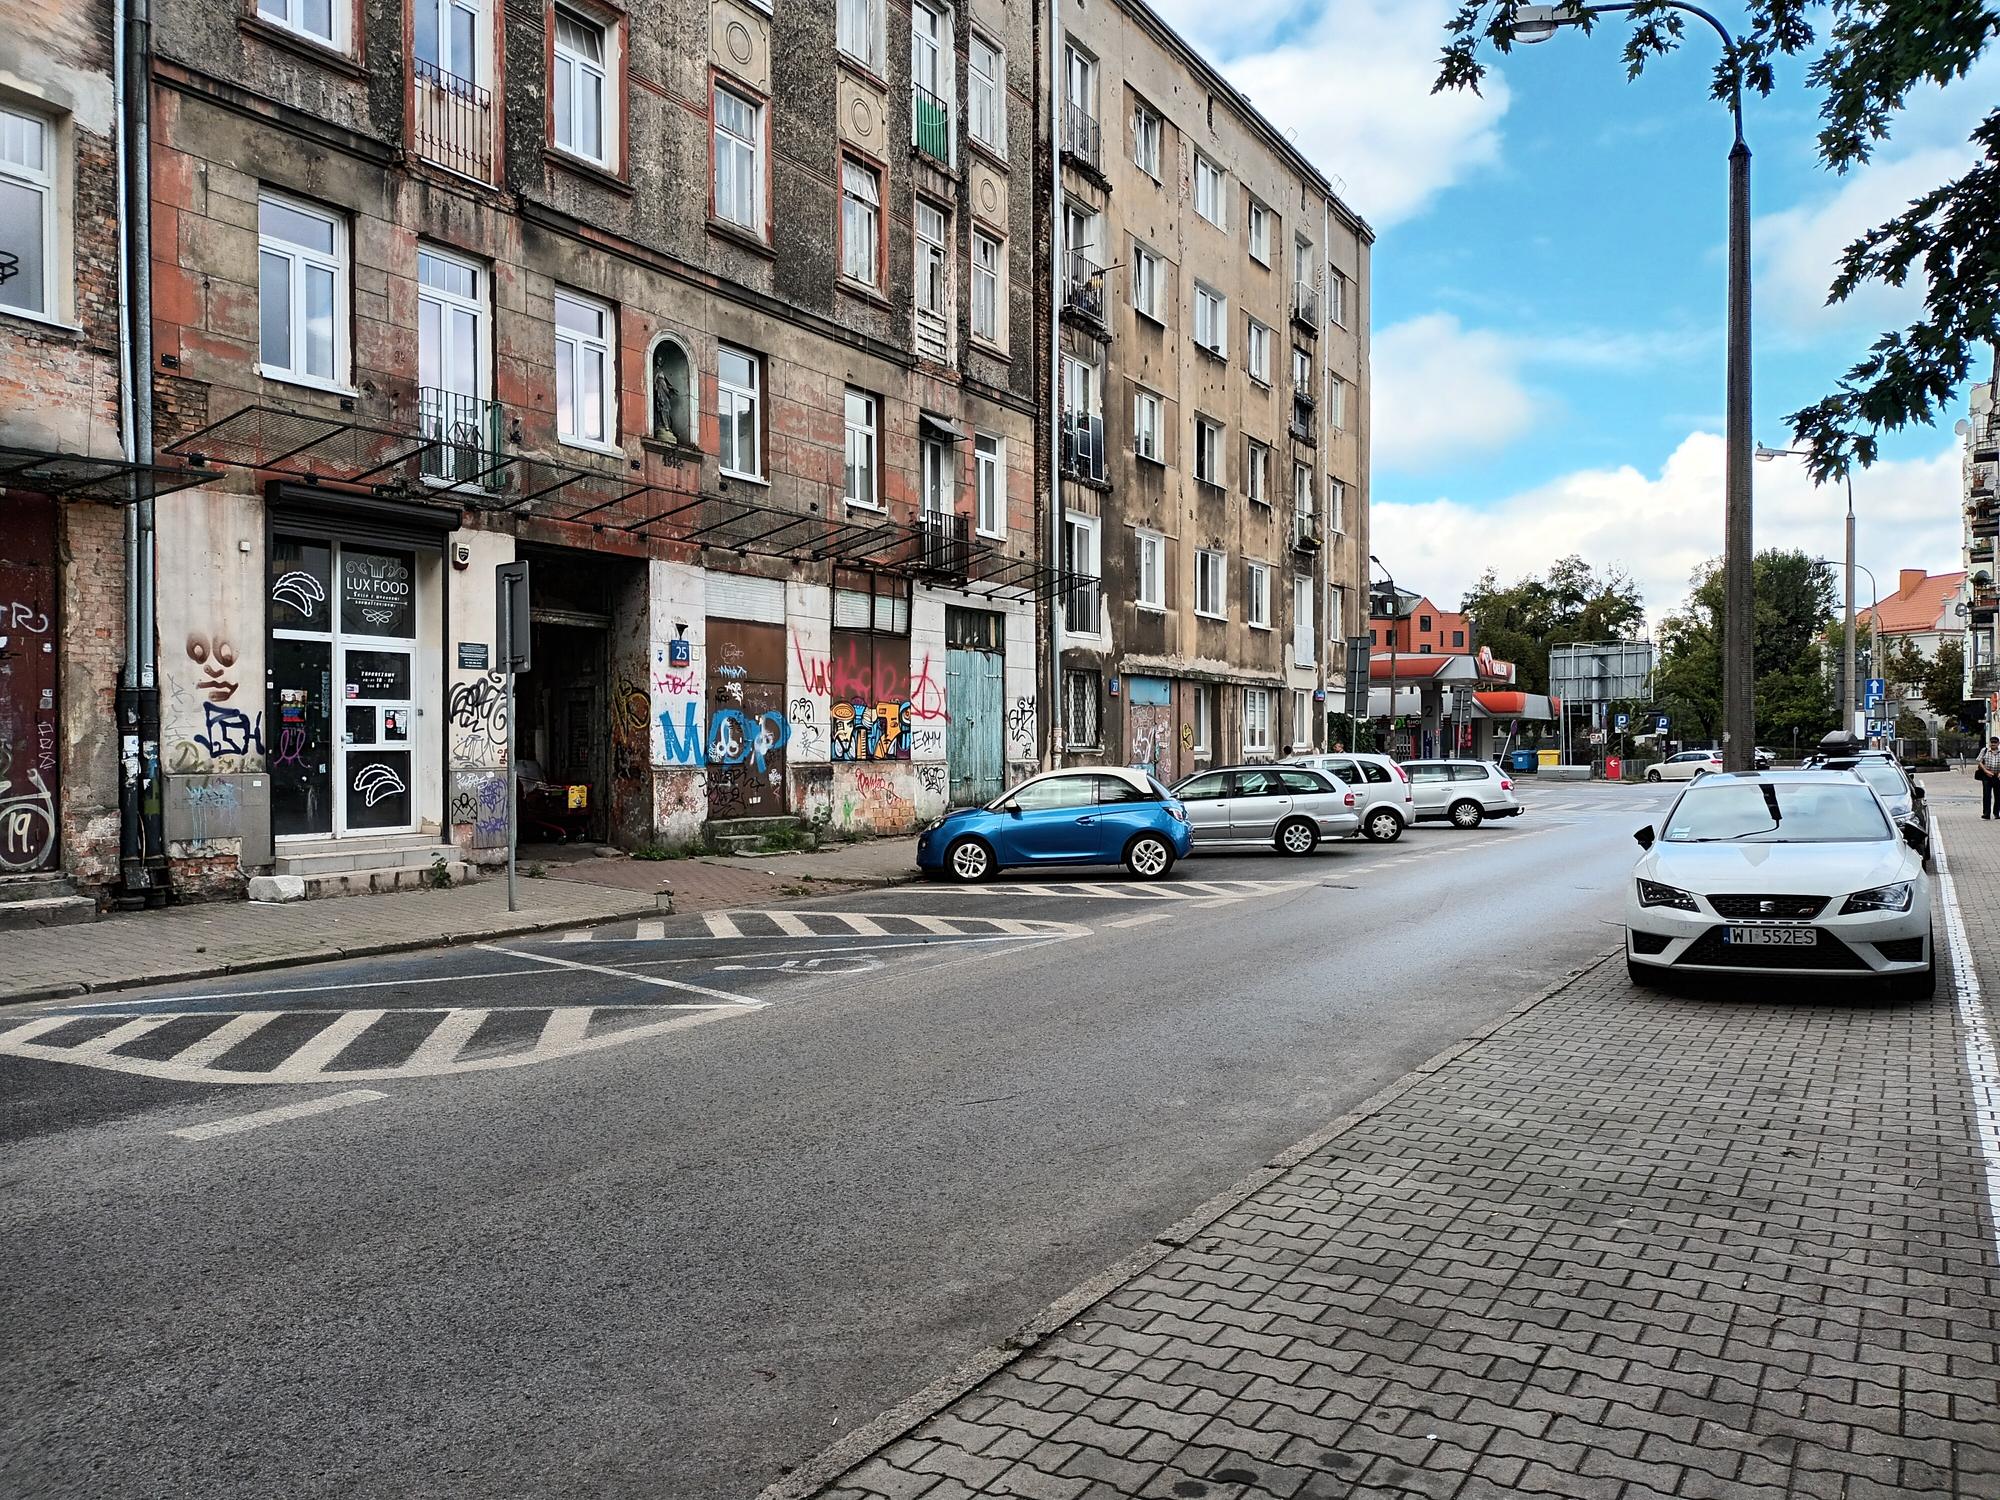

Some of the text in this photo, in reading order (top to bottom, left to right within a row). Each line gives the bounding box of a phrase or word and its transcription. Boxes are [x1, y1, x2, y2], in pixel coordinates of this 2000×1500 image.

[346, 576, 409, 595] LUX FOOD
[675, 646, 687, 660] 25
[1425, 705, 1433, 717] 2
[1618, 716, 1626, 725] P
[1659, 718, 1667, 727] P
[1732, 929, 1814, 945] WI 552ES
